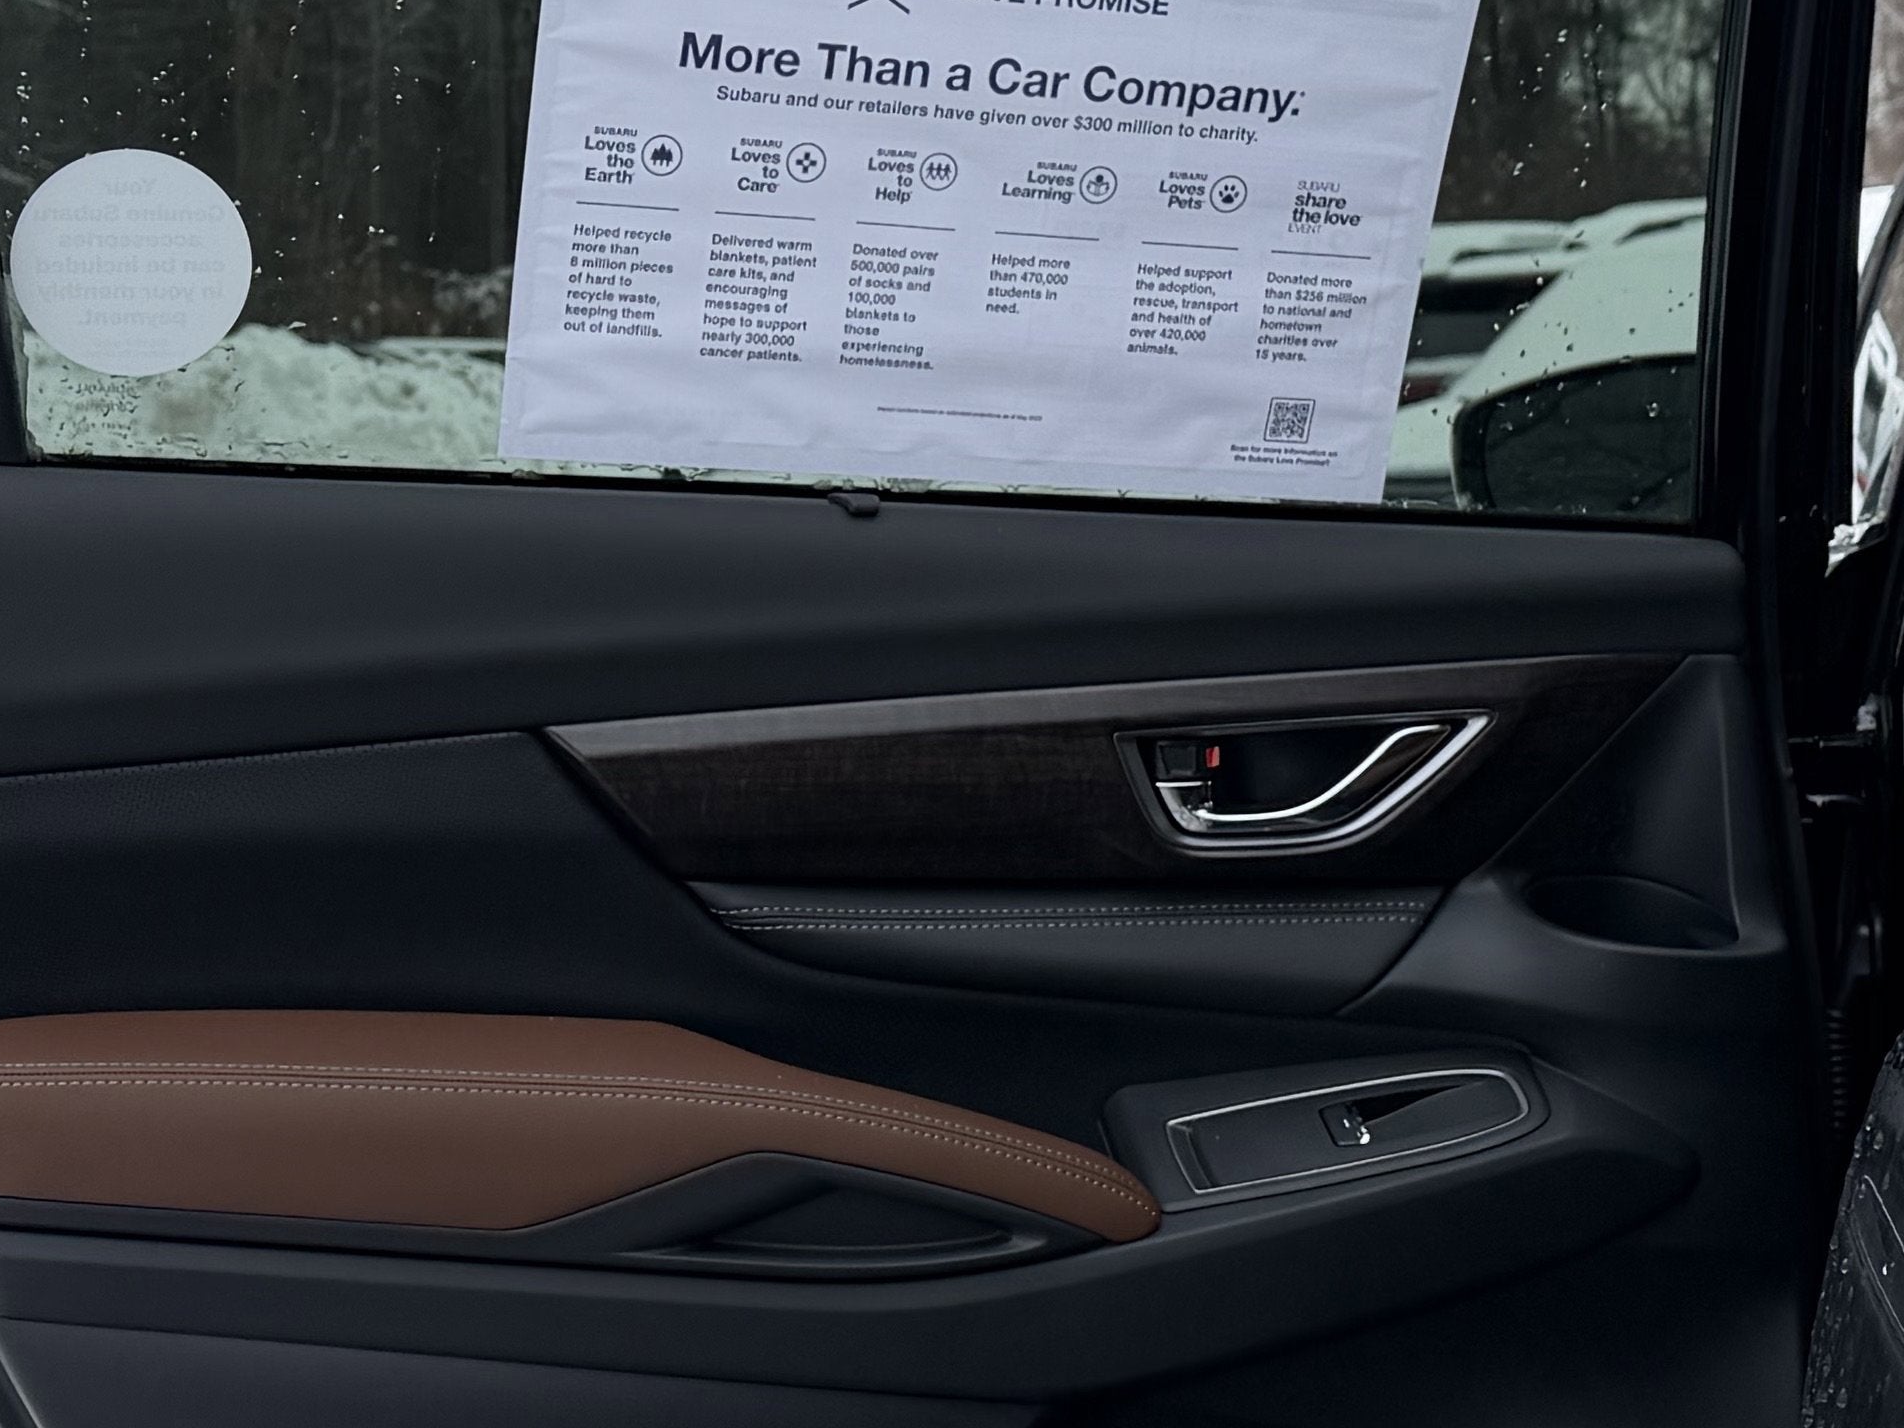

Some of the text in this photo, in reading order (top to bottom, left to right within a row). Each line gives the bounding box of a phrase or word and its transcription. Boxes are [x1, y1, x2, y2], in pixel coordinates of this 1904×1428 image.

[678, 32, 800, 77] More
[816, 43, 930, 88] Than
[945, 64, 971, 92] a
[988, 59, 1068, 98] Car
[716, 85, 1258, 144] Subaru and our retailers have given over $300 million to charity.
[594, 126, 637, 136] SUBARU
[585, 136, 636, 153] Loves
[740, 138, 782, 148] SUBARU
[606, 154, 634, 168] the
[731, 148, 780, 164] Loves
[877, 148, 917, 159] SUBARU
[763, 166, 779, 178] to
[868, 158, 914, 173] Loves
[1037, 161, 1077, 171] SUBARU
[585, 167, 632, 184] Earth
[897, 174, 912, 187] to
[1027, 171, 1074, 186] Loves
[1169, 172, 1207, 181] SUBARU
[737, 177, 777, 192] Care
[1159, 181, 1205, 196] Loves
[875, 187, 911, 204] Help
[1002, 183, 1072, 204] Learning
[1295, 193, 1346, 209] share
[1168, 195, 1202, 209] Pets
[1292, 208, 1360, 226] the love
[573, 224, 671, 242] Helped recycle
[572, 242, 639, 255] more than
[712, 234, 812, 251] Delivered warm
[710, 251, 816, 268] blankets, patient
[853, 244, 938, 261] Donated over
[582, 258, 626, 271] million
[631, 261, 673, 274] pieces
[851, 260, 934, 277] 500,000 pairs
[992, 254, 1070, 270] Helped more
[708, 267, 794, 282] care kits, and
[990, 271, 1068, 286] than 470,000
[1137, 263, 1232, 280] Helped support
[569, 273, 632, 286] of hard to
[849, 277, 930, 292] of socks and
[1267, 272, 1352, 288] Donated more
[706, 282, 787, 300] encouraging
[988, 287, 1057, 301] students in
[1136, 279, 1215, 296] the adoption,
[567, 289, 660, 307] recycle waste,
[848, 292, 896, 306] 100,000
[1265, 288, 1291, 300] than
[1327, 292, 1367, 305] million
[565, 304, 654, 320] keeping them
[705, 298, 787, 314] messages of
[986, 301, 1019, 314] need.
[1133, 296, 1238, 313] rescue, transport
[1263, 304, 1352, 319] to national and
[846, 308, 916, 323] blankets to
[1131, 311, 1211, 326] and health of
[564, 321, 662, 338] out of landfills.
[703, 314, 807, 333] hope to support
[844, 324, 879, 336] those
[1260, 319, 1321, 332] hometown
[702, 331, 794, 347] nearly 300,000
[1129, 328, 1206, 341] over 420,000
[1257, 334, 1337, 348] charities over
[700, 347, 802, 363] cancer patients.
[842, 340, 923, 356] experiencing
[840, 355, 933, 370] homelessness.
[1272, 351, 1306, 363] years.
